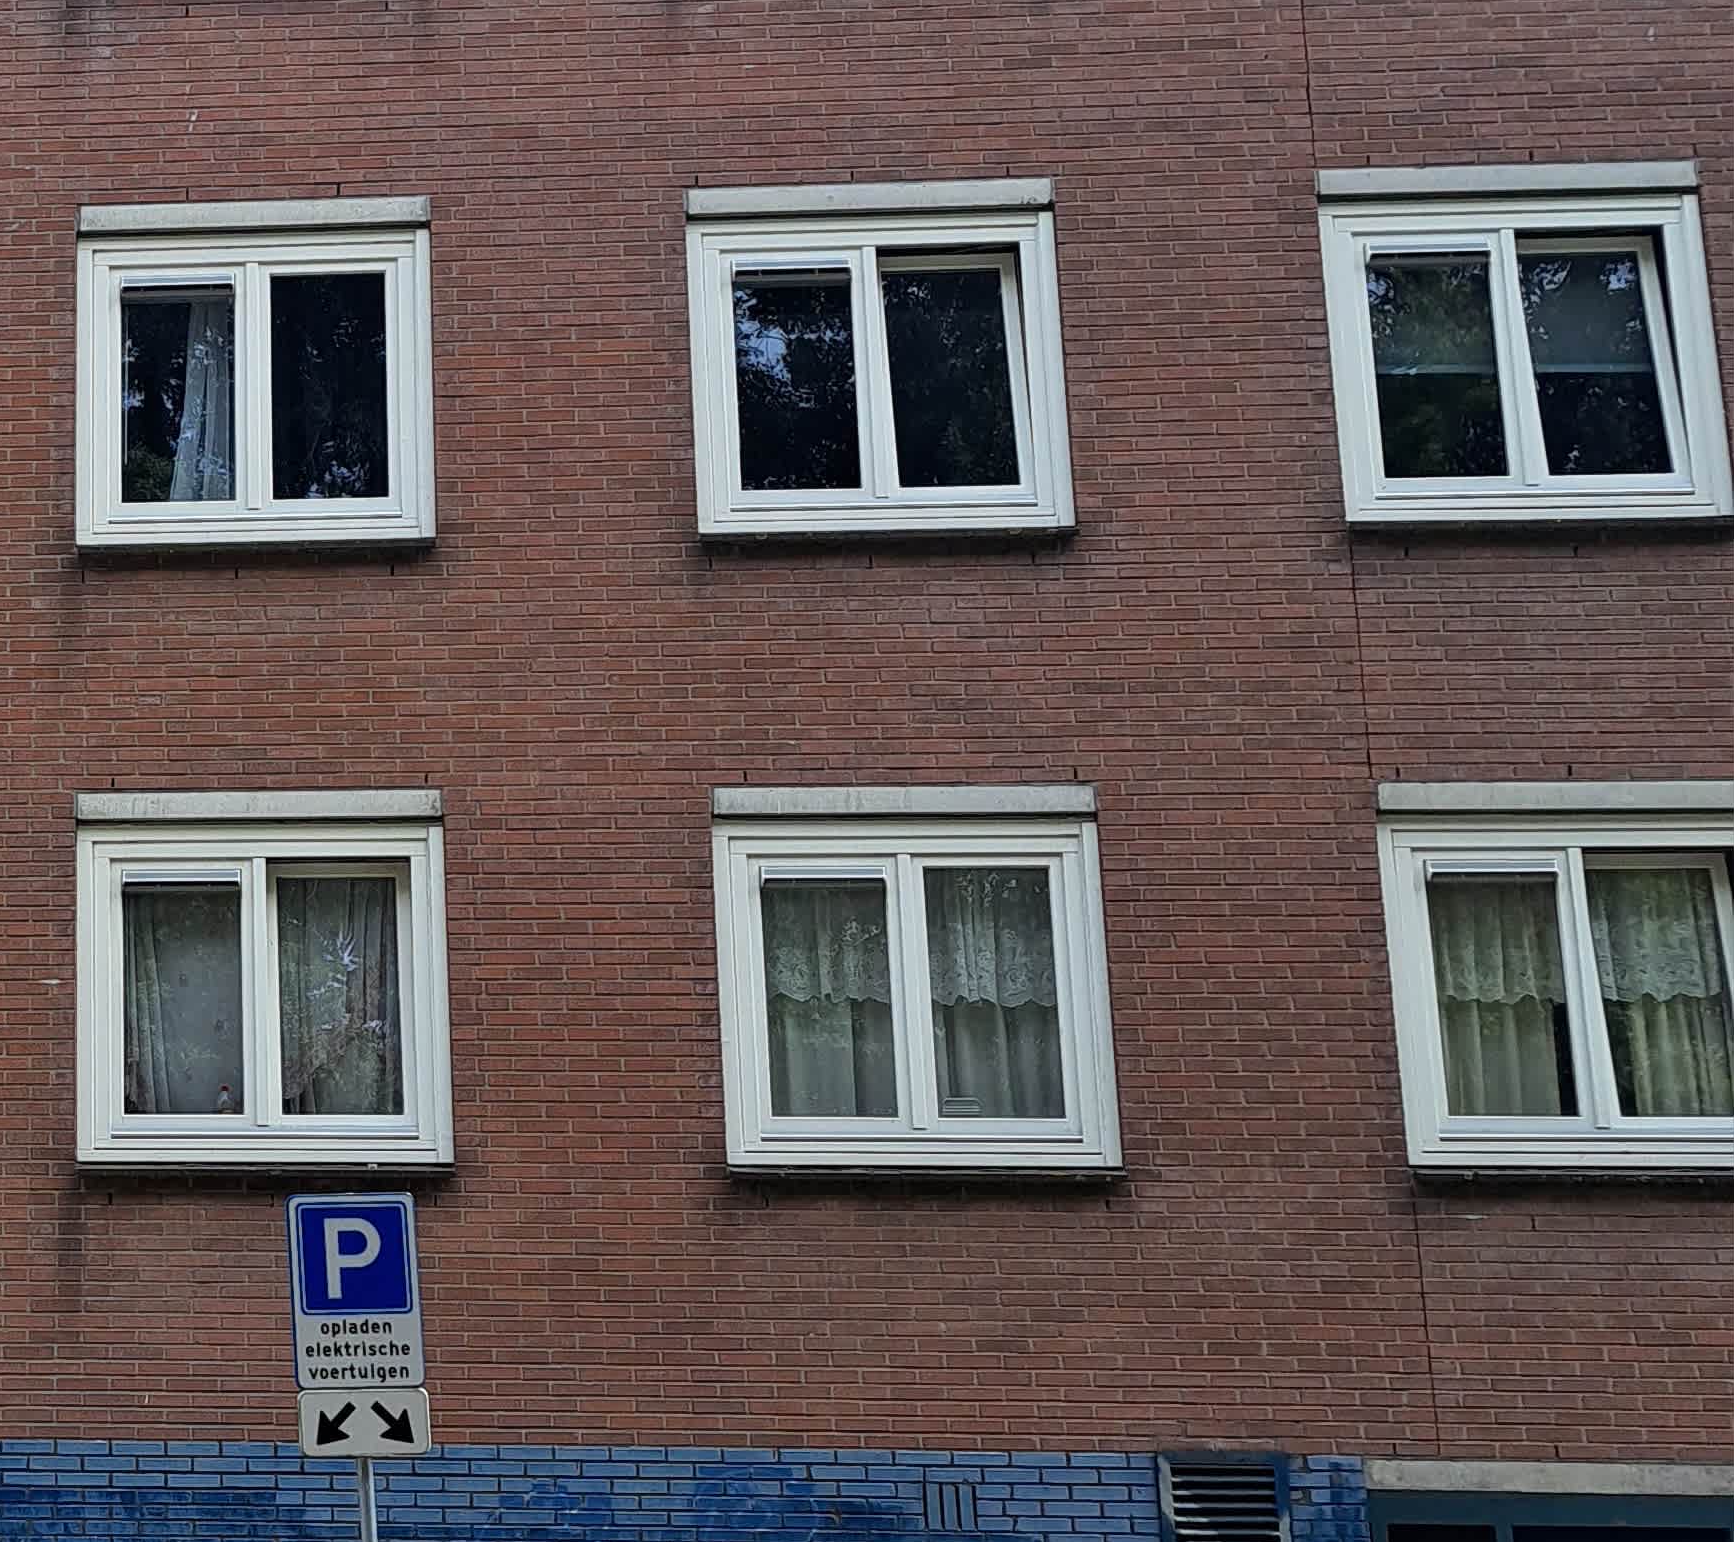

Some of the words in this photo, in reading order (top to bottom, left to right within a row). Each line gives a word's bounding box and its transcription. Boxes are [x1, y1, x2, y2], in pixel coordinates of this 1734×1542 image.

[324, 1217, 382, 1300] P
[320, 1318, 393, 1338] opladen
[305, 1340, 411, 1358] elektrische
[308, 1362, 409, 1384] voertuigen
